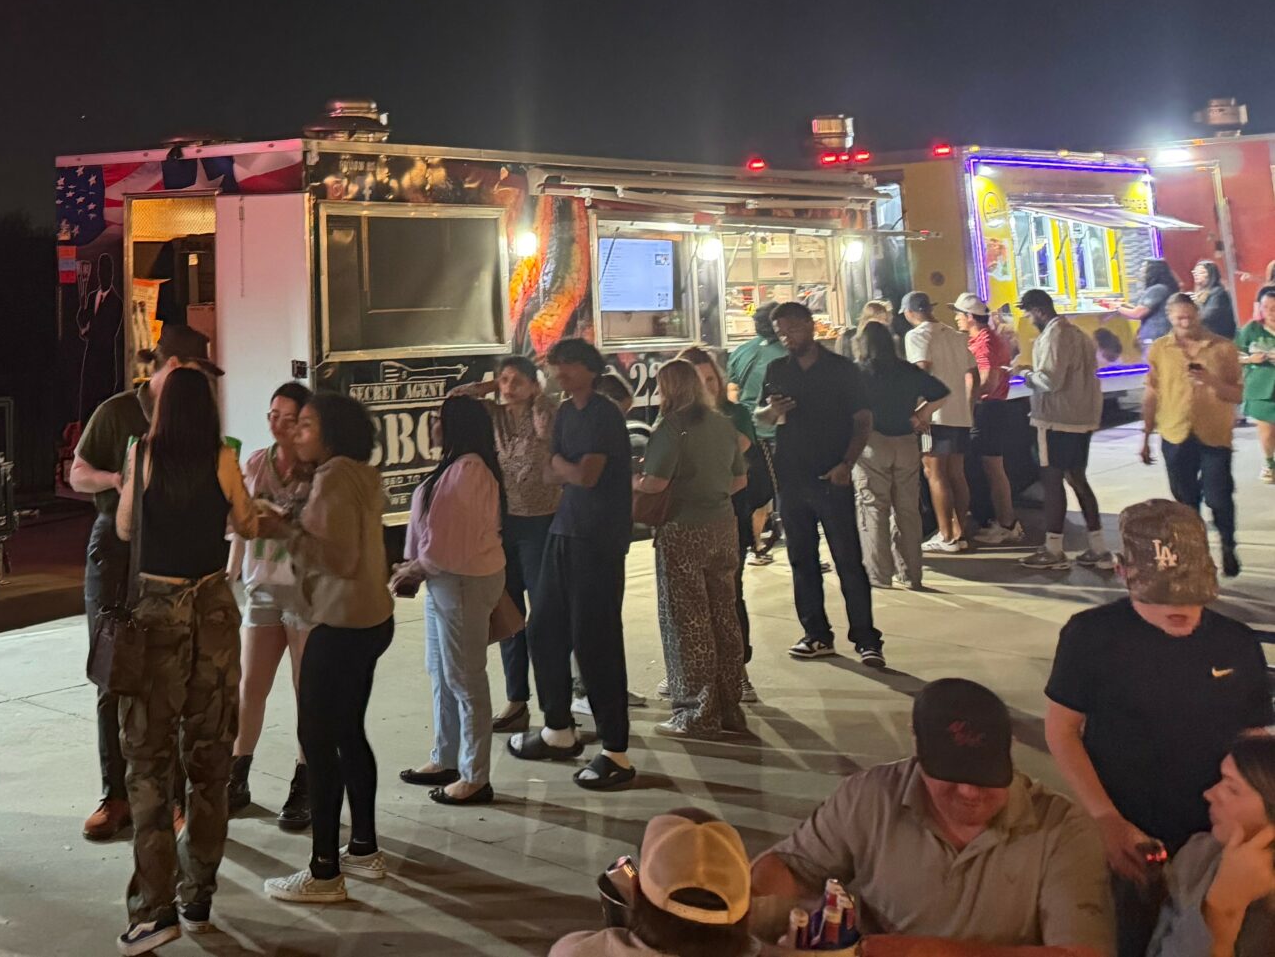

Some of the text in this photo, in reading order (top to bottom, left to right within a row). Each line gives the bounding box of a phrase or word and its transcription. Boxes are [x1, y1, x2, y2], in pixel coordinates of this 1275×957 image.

[349, 381, 446, 402] SECRET AGENT
[1151, 538, 1178, 571] LA
